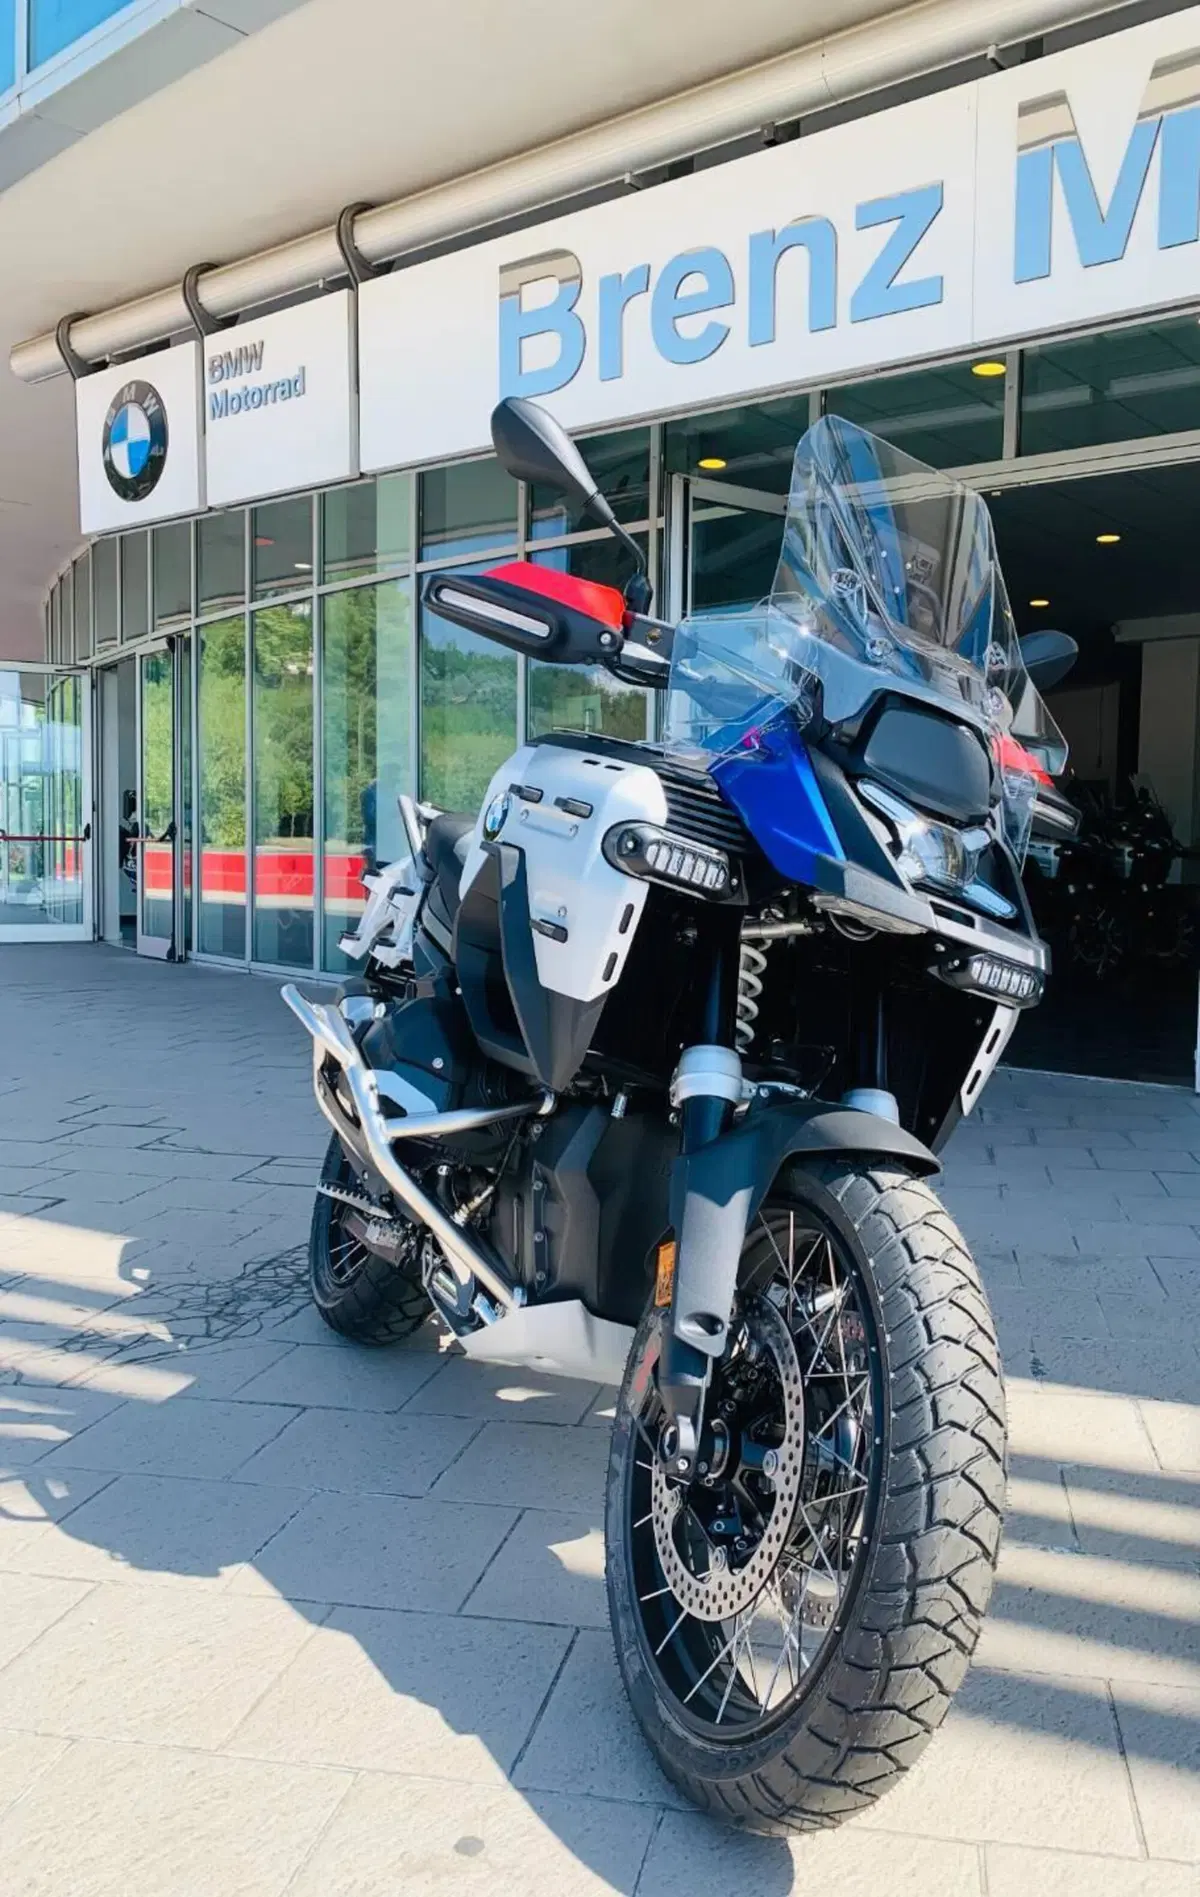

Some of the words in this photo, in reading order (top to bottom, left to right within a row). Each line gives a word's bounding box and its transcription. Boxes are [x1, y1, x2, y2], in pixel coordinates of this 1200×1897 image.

[498, 179, 944, 401] Brenz
[208, 339, 264, 385] BMW
[209, 365, 305, 421] Motorrad
